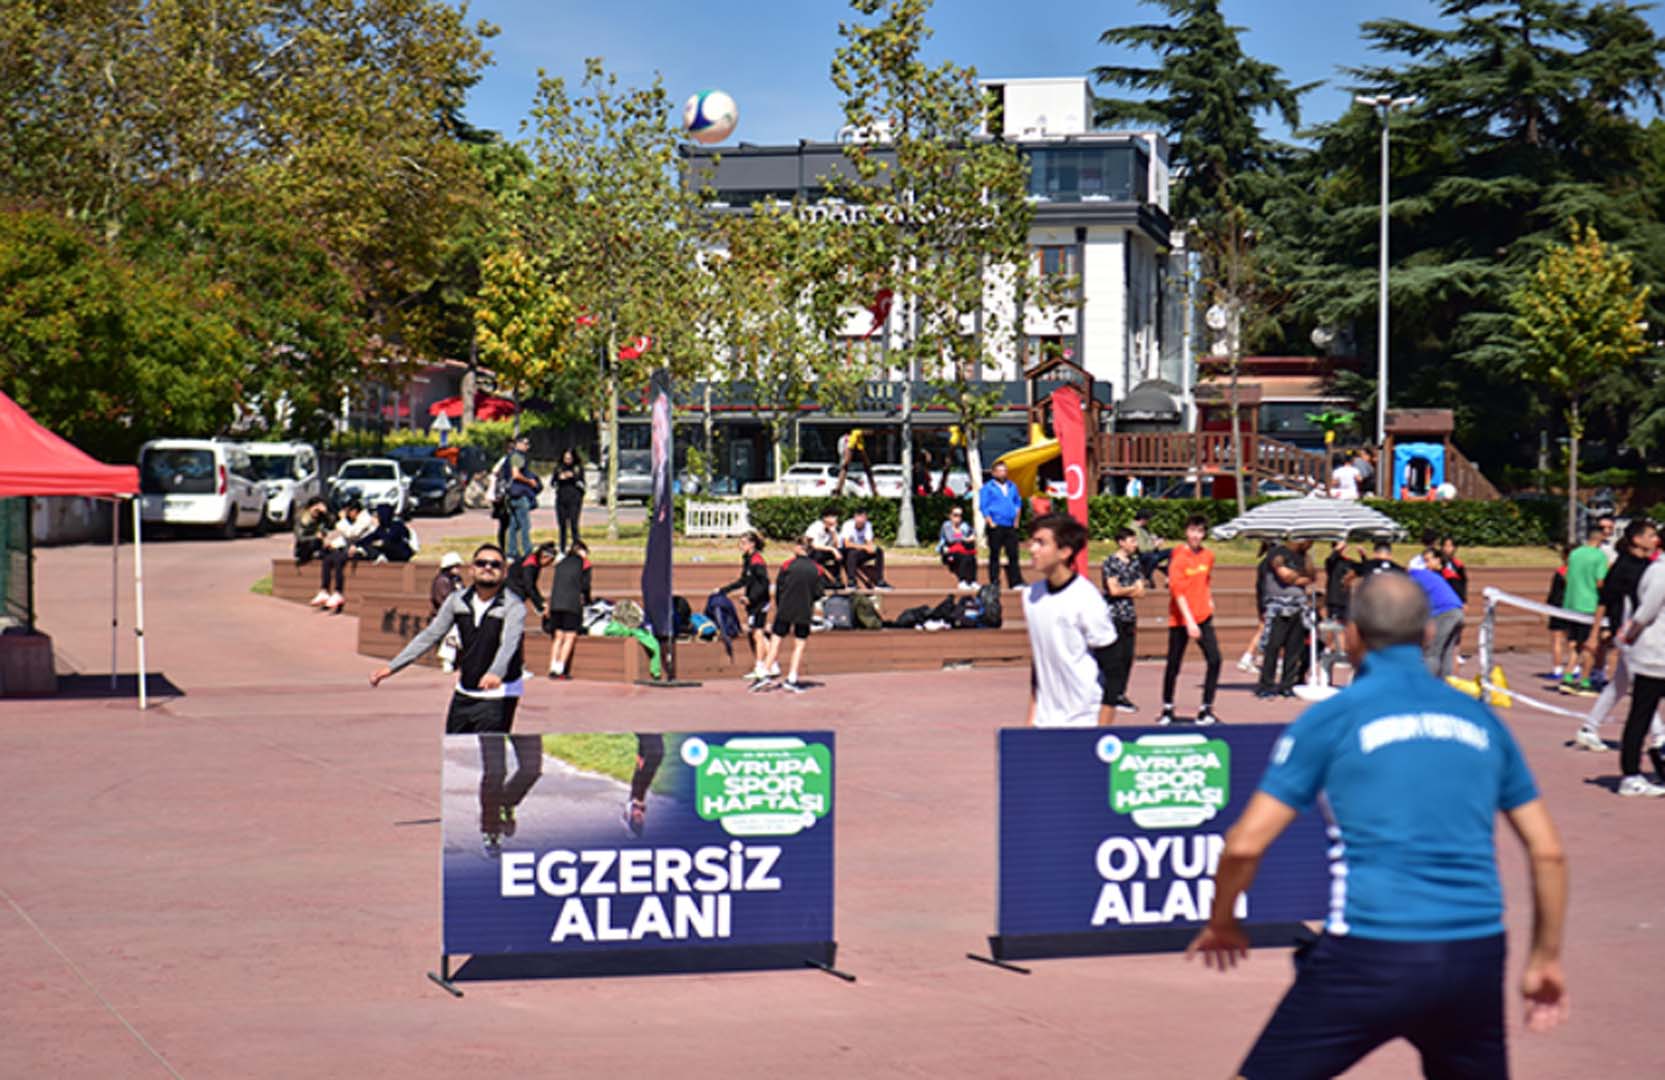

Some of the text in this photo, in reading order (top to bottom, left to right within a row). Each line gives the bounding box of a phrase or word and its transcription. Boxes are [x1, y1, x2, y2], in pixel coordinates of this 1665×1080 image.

[706, 757, 822, 775] AVRUPA
[1118, 752, 1221, 771] AVRUPA
[723, 775, 805, 795] SPOR
[1135, 770, 1206, 790] SPOR
[703, 793, 823, 815] HAFTASI
[1115, 787, 1223, 808] HAFTASI
[550, 894, 732, 942] ALANI
